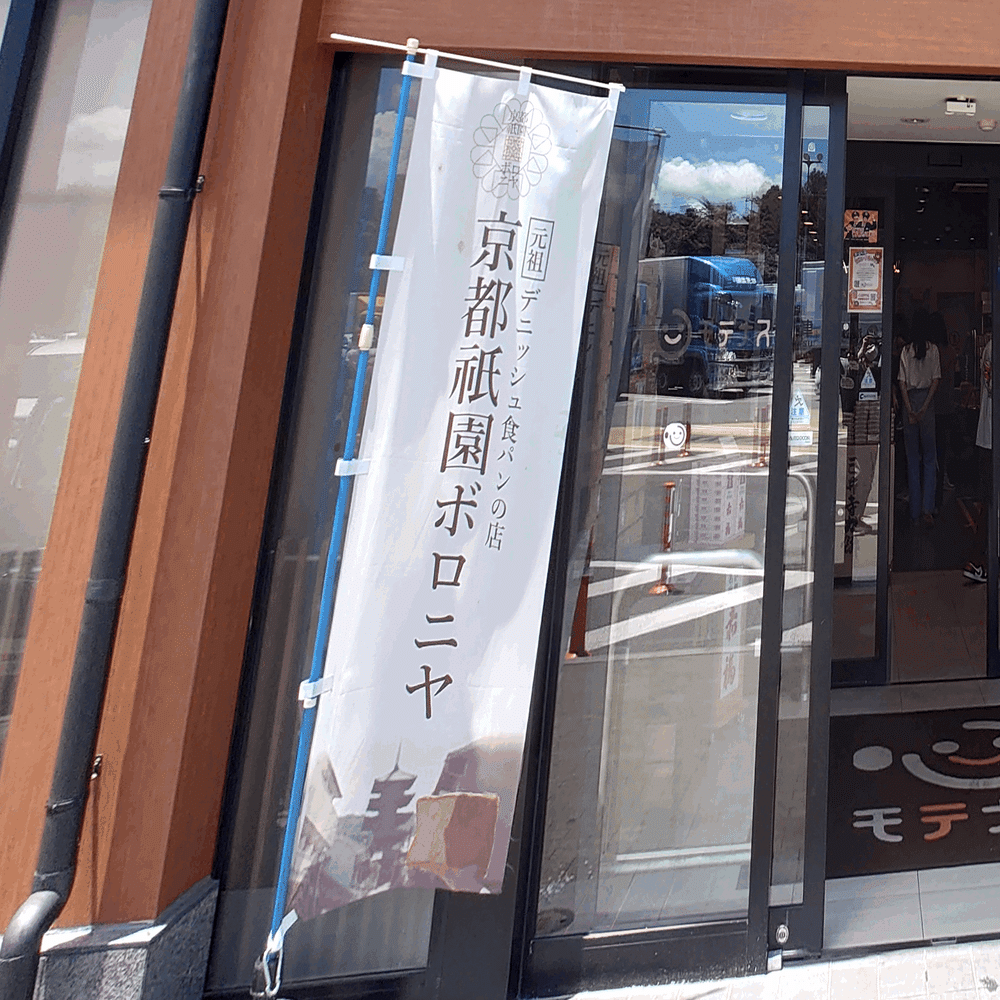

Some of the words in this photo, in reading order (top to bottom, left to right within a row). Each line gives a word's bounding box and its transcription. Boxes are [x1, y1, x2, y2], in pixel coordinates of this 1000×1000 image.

[406, 211, 523, 719] 京都祇園ボロニヤ
[485, 287, 541, 551] デニッシュ食パンの店
